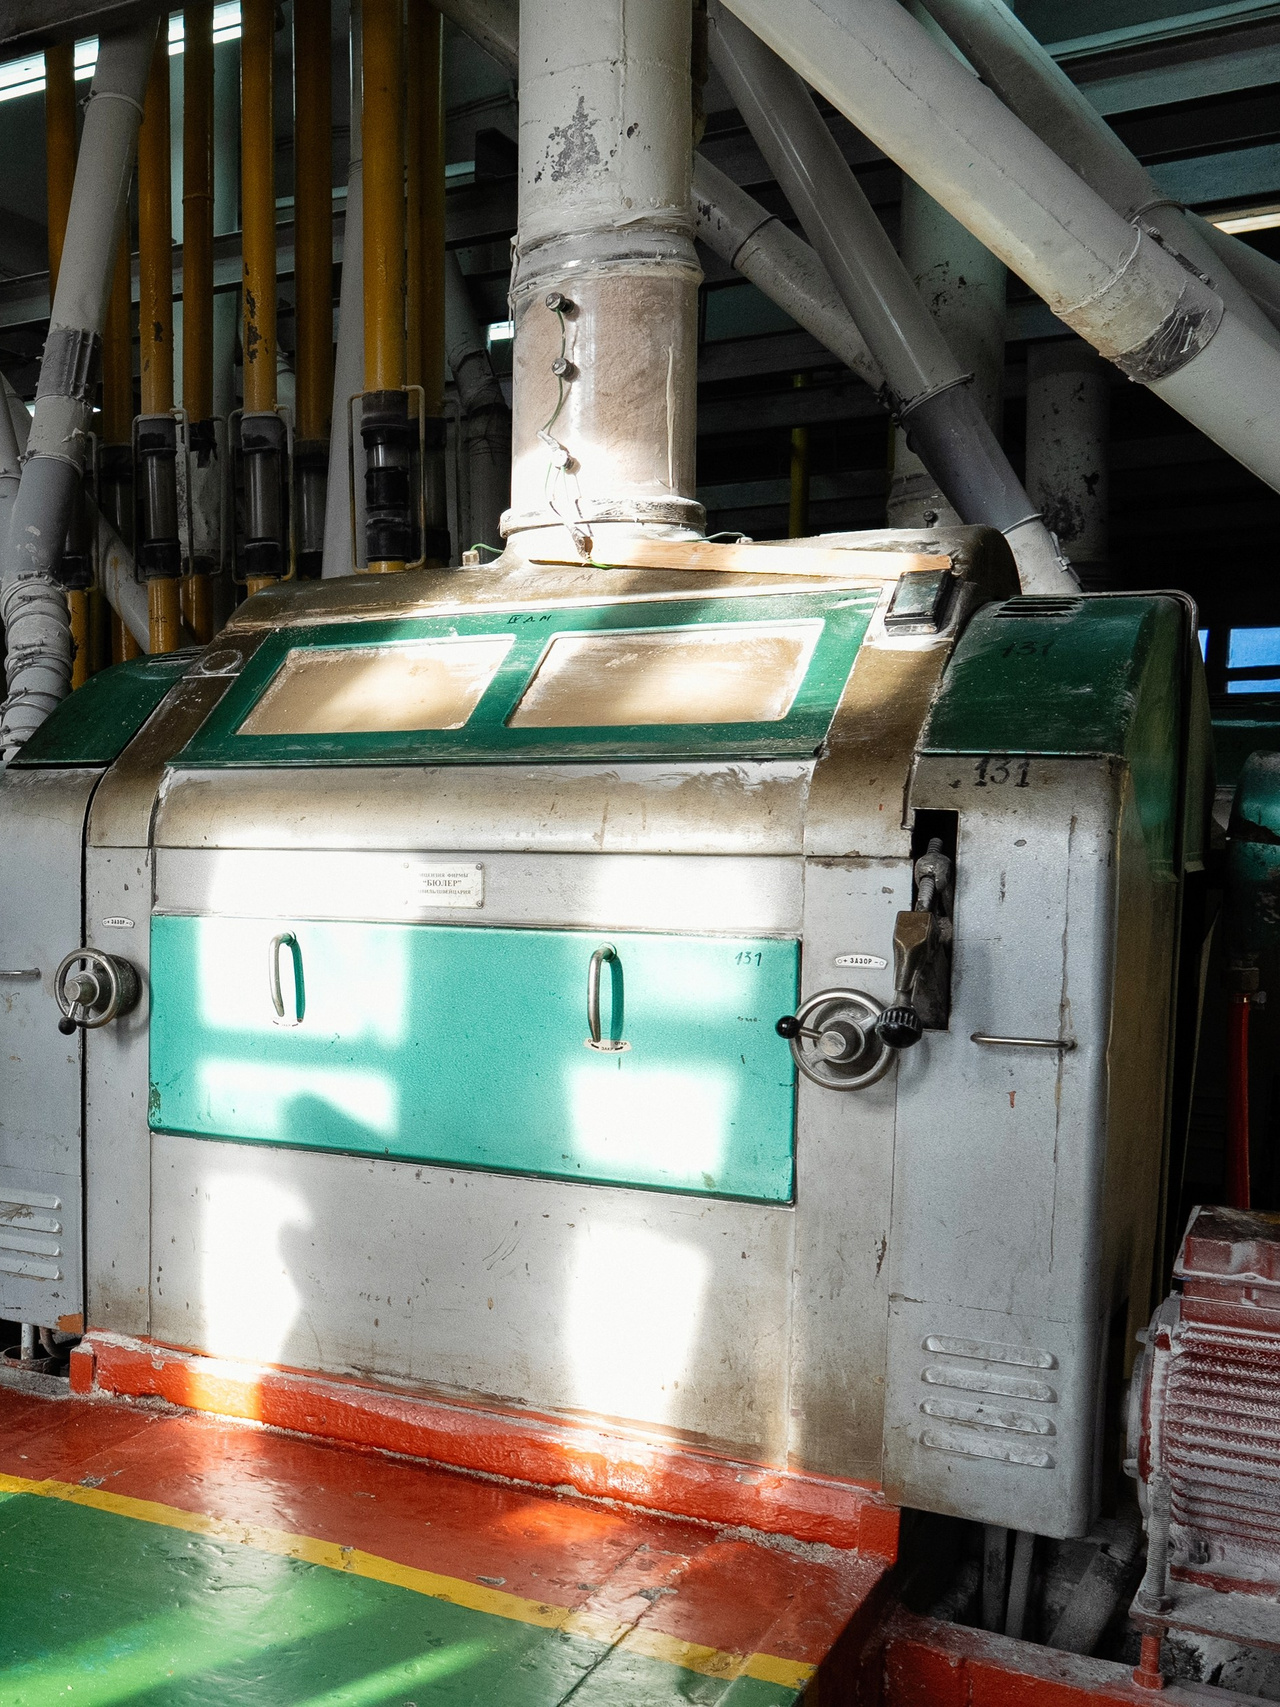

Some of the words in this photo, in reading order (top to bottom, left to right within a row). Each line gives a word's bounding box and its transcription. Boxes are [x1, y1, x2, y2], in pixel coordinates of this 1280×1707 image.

[1000, 640, 1055, 658] 131
[974, 757, 1031, 788] 131
[734, 951, 762, 967] 131
[849, 957, 873, 965] ЗАЗОР
